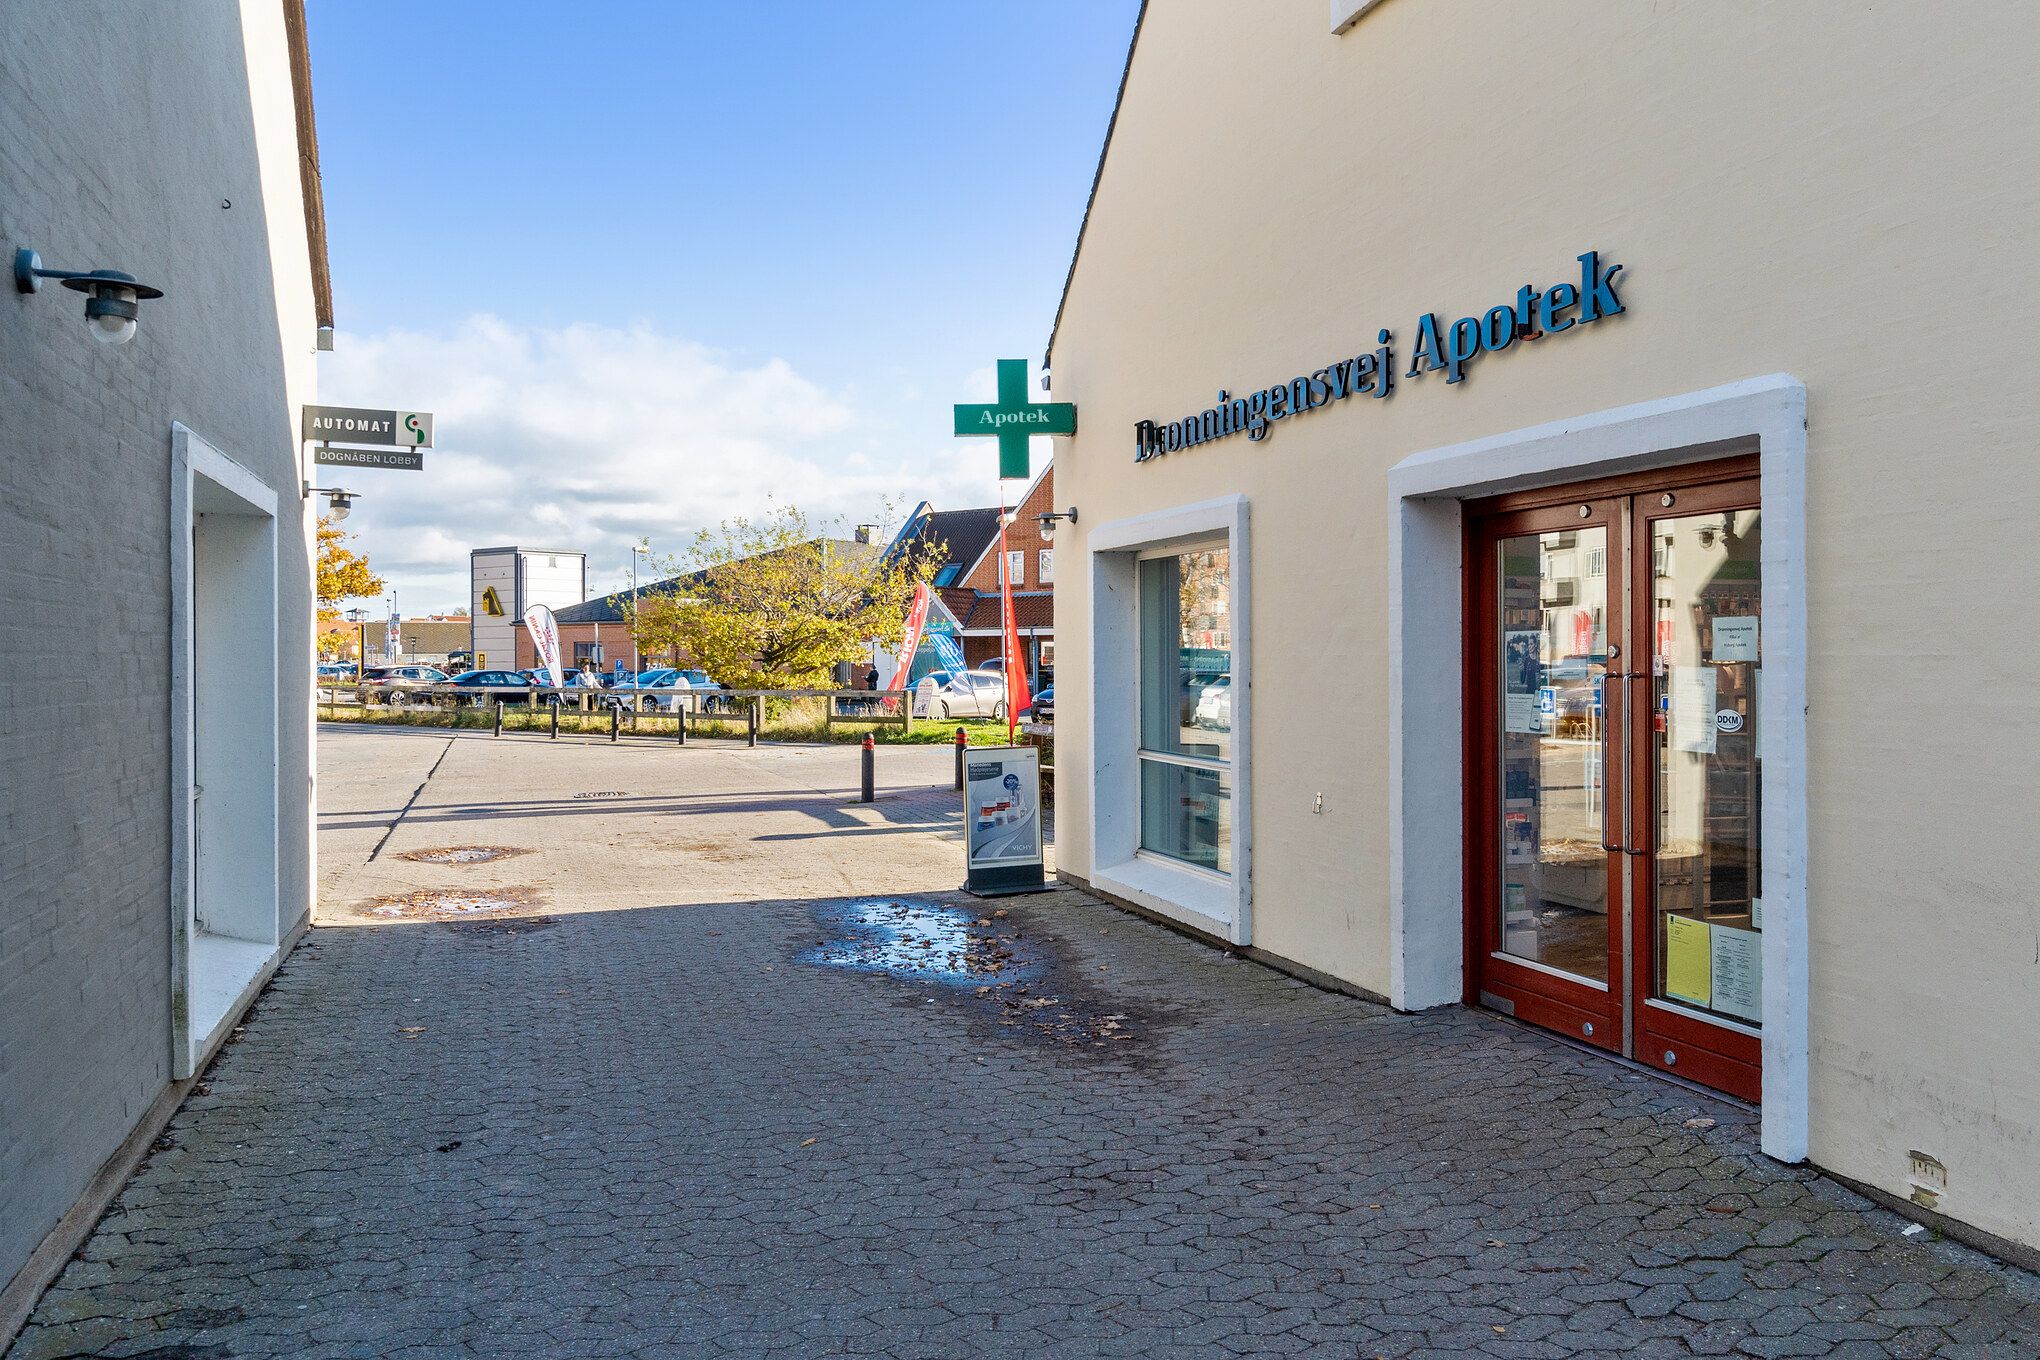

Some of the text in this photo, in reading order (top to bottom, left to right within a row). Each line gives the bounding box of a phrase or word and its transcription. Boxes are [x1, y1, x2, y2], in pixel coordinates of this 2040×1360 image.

[1134, 250, 1628, 464] Dronningensvej Apotek
[313, 417, 390, 432] AUTOMAT
[978, 408, 1050, 427] Apotek
[383, 455, 418, 465] LOBBY
[617, 660, 622, 668] P
